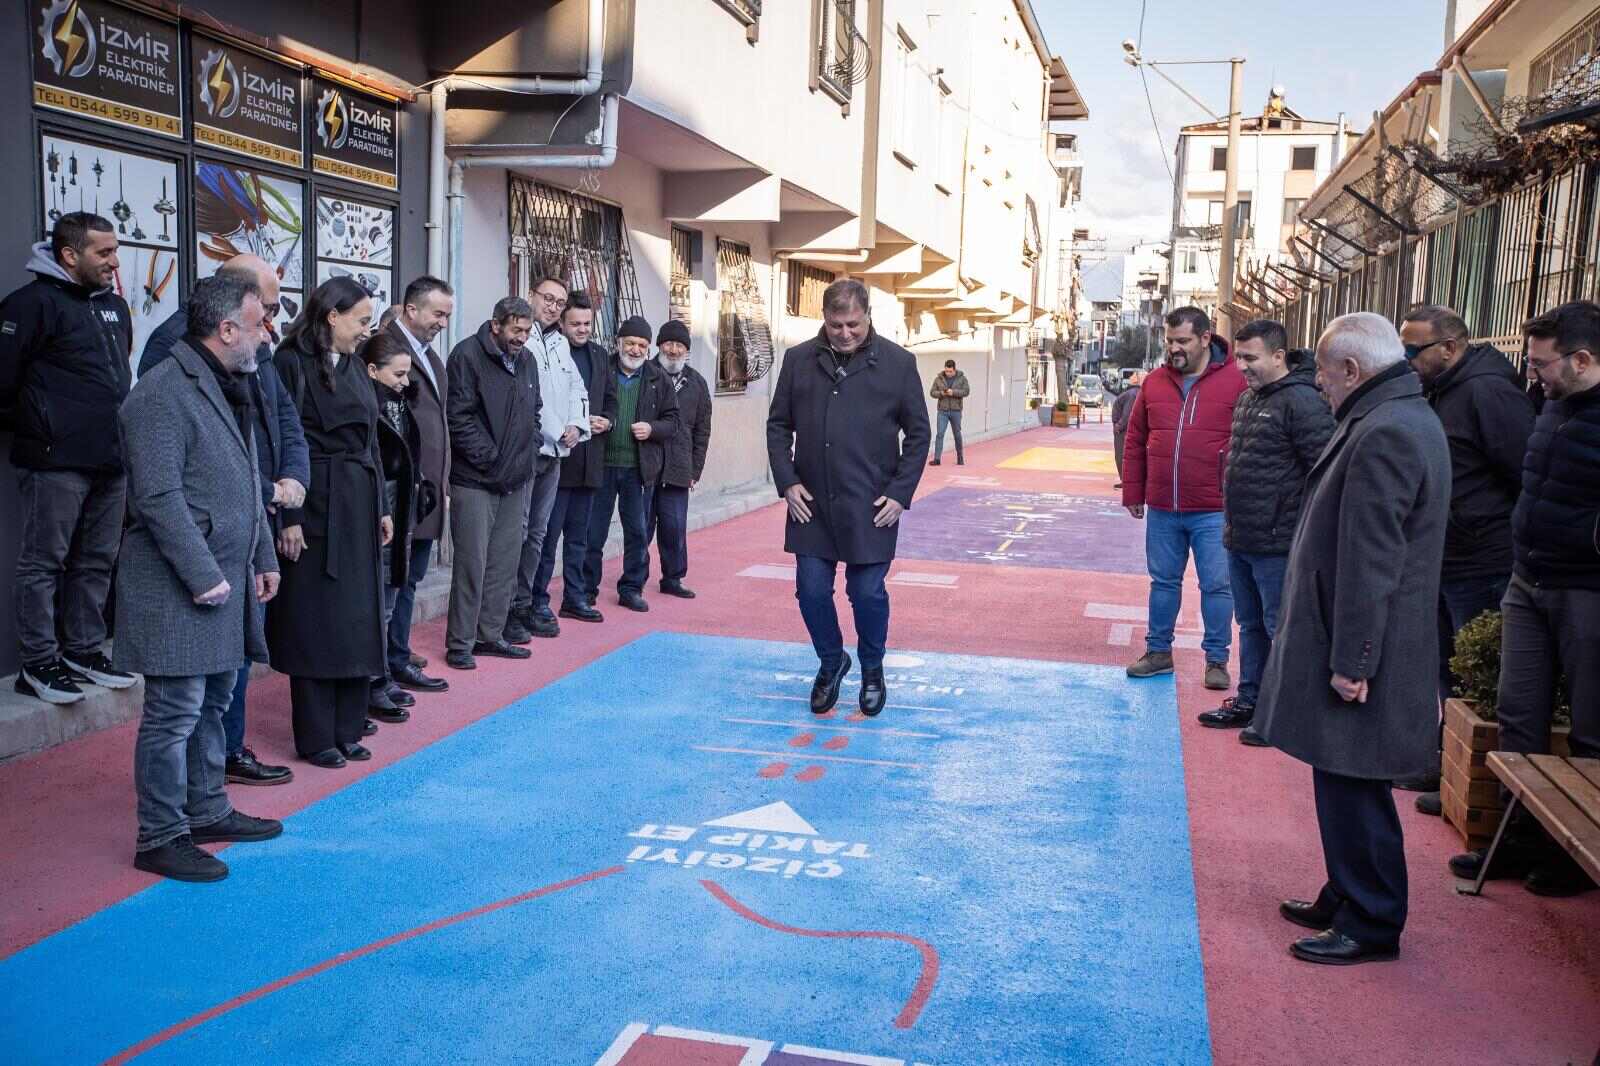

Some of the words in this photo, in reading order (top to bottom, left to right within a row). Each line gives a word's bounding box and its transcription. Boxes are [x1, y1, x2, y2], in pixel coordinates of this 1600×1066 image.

[100, 17, 170, 63] İZMİR
[106, 51, 167, 78] ELEKTRİK
[99, 65, 175, 96] PARATONER
[243, 66, 295, 104] İZMİR
[36, 87, 64, 104] TEL:
[69, 96, 107, 115] 0544
[113, 107, 140, 122] 599
[144, 114, 159, 128] 91
[240, 106, 298, 133] PARATONER
[246, 95, 292, 118] ELEKTRİK
[350, 101, 391, 133] İZMİR
[218, 134, 247, 149] 0544
[251, 142, 271, 156] 599
[274, 149, 286, 161] 91
[348, 138, 394, 158] PARATONER
[353, 127, 390, 146] ELEKTRİK
[628, 823, 697, 841] ET
[708, 831, 873, 859] TAKİP
[626, 845, 844, 878] ÇİZGİYİ
